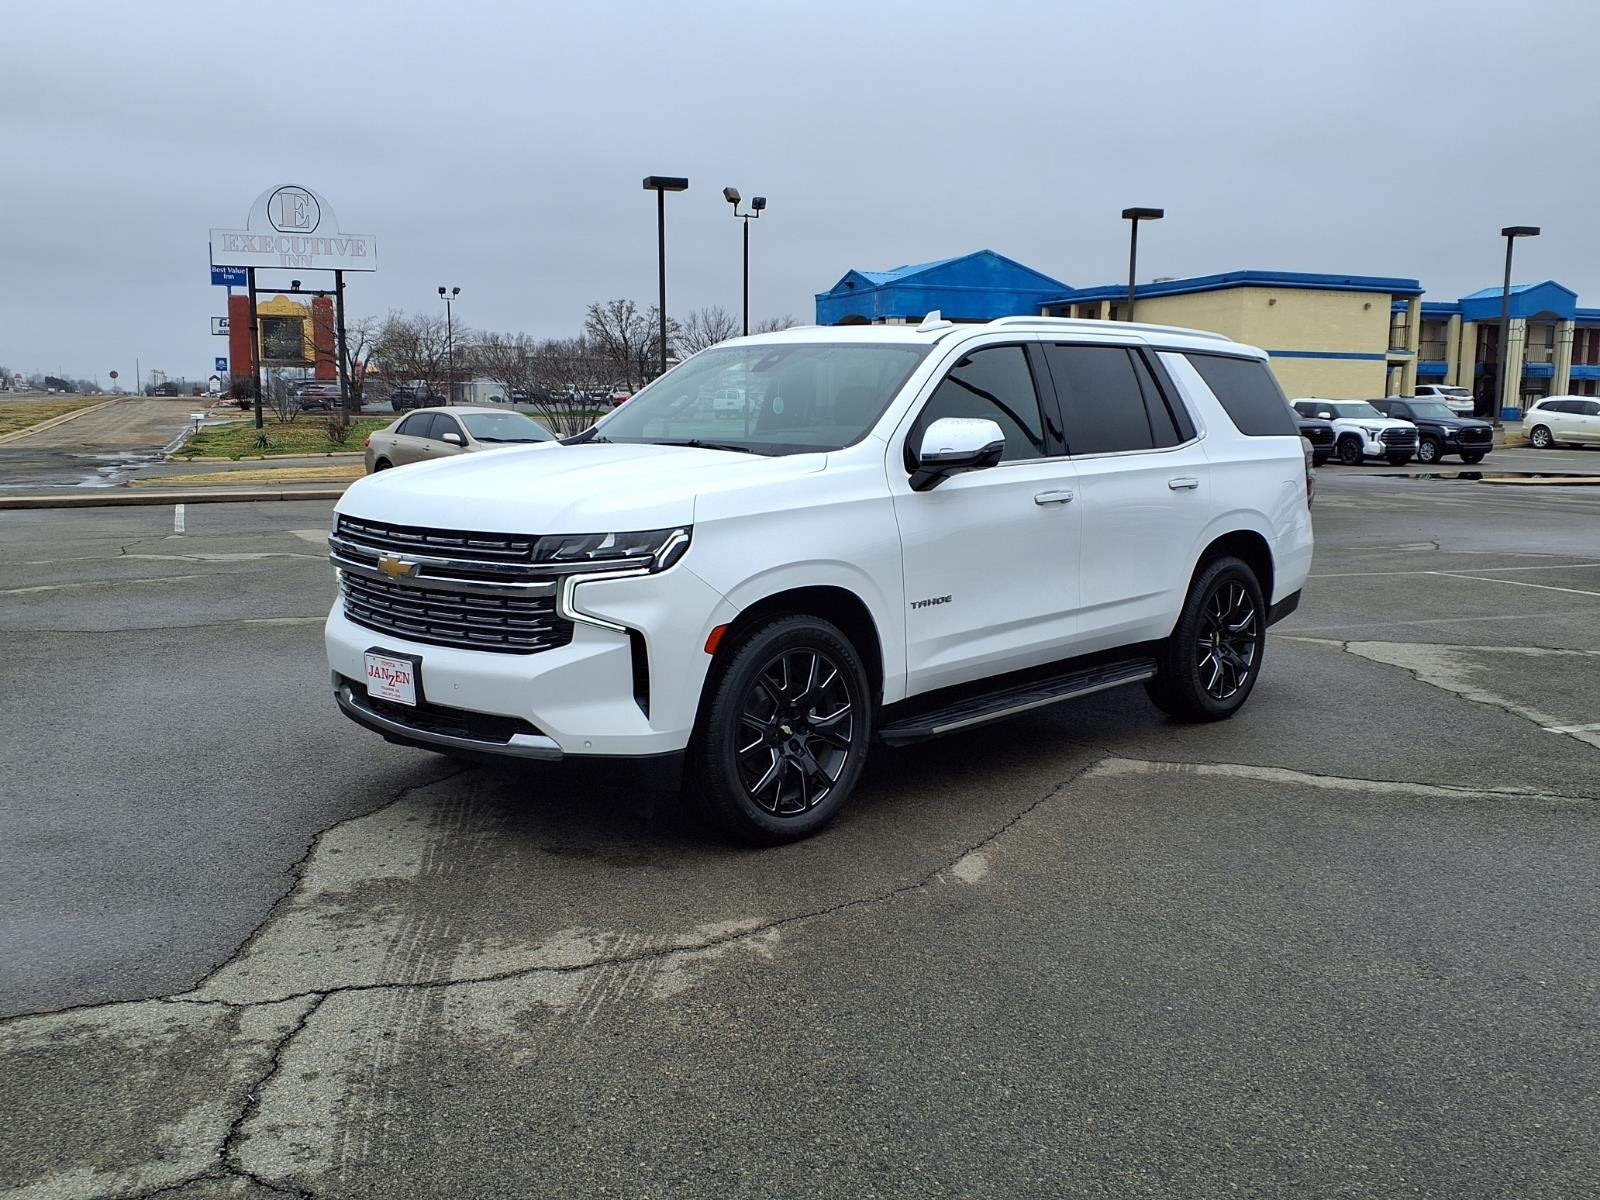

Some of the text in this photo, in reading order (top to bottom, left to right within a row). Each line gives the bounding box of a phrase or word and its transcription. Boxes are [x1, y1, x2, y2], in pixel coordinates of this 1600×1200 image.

[277, 193, 310, 229] E
[222, 234, 366, 257] EXECUTIVE
[279, 255, 313, 267] INN
[910, 594, 953, 610] TAHOE
[368, 664, 411, 687] JANZEN
